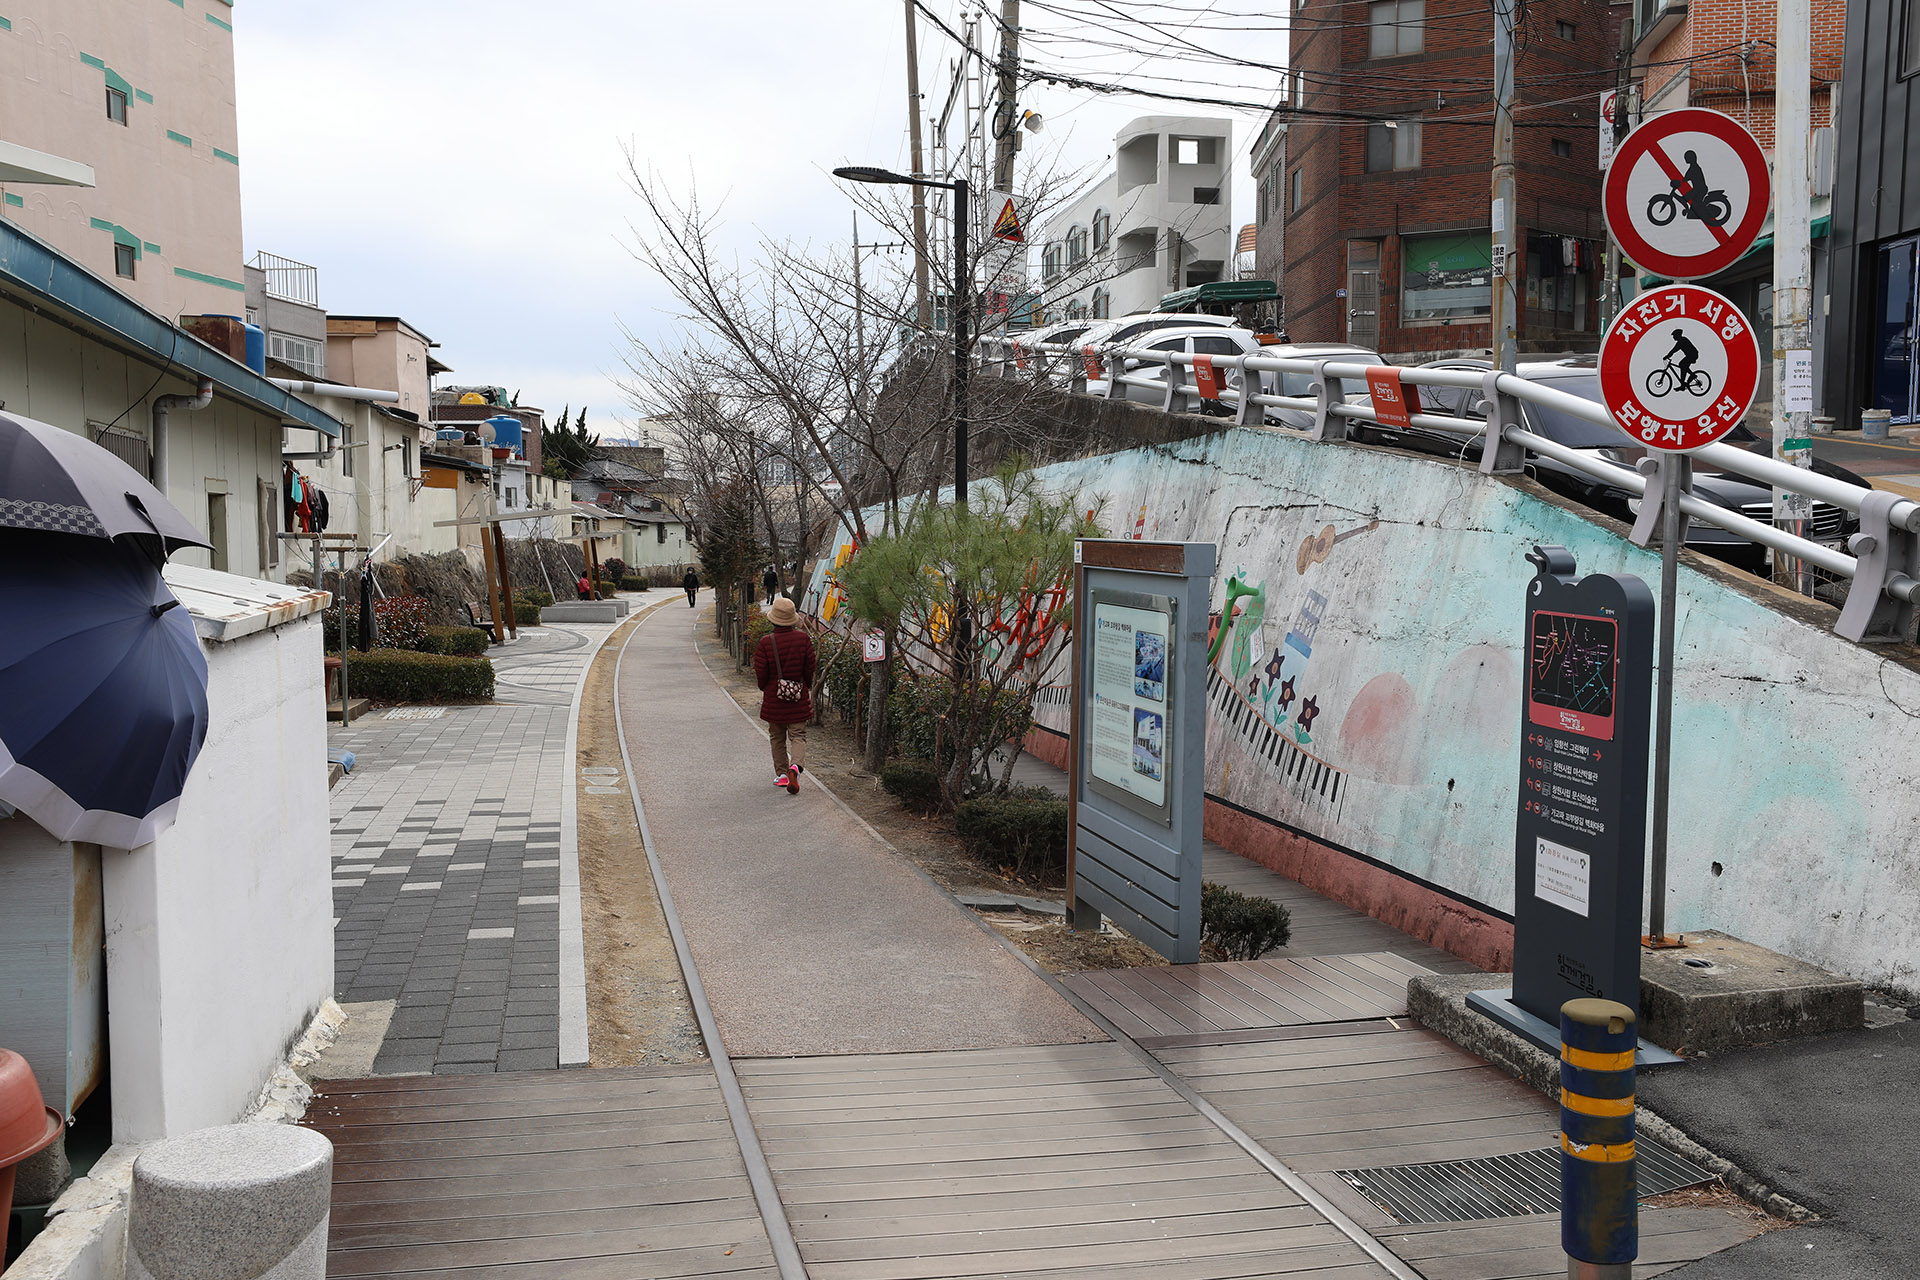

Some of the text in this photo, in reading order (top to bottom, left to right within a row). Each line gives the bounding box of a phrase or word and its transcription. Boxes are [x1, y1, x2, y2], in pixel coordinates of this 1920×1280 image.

[1615, 294, 1744, 343] 자전거 서행
[1615, 395, 1740, 446] 보행자 우선
[1573, 767, 1598, 782] 마산박물관
